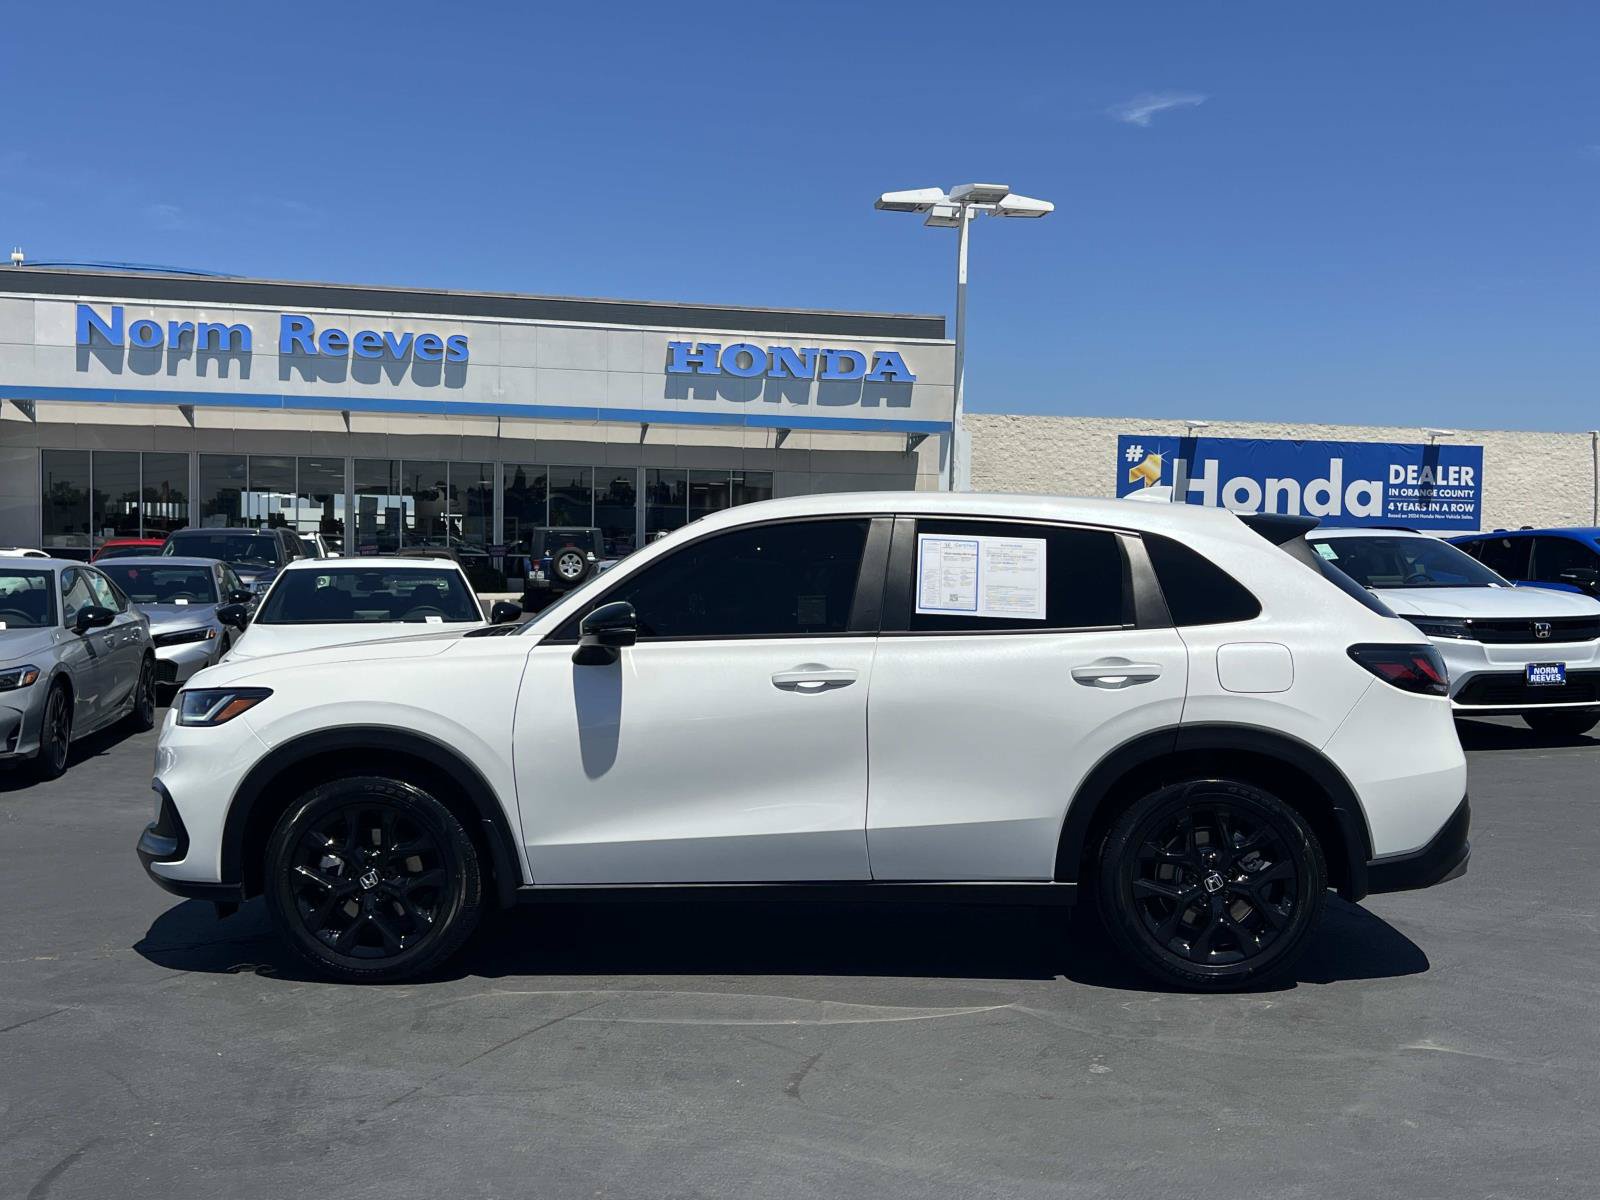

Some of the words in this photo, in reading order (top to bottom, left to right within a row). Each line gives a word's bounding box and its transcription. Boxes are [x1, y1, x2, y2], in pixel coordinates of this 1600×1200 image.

[76, 304, 252, 352] Norm
[279, 314, 470, 362] Reeves
[667, 341, 917, 382] HONDA
[1389, 464, 1475, 487] DEALER
[1172, 458, 1384, 518] Honda
[1388, 488, 1399, 496] IN
[1400, 488, 1438, 498] ORANGE
[1439, 489, 1475, 498] COUNTY
[1388, 502, 1395, 511] 4
[1396, 502, 1427, 512] YEARS
[1428, 503, 1440, 512] IN
[1441, 503, 1449, 512] A
[1450, 503, 1475, 513] ROW
[1530, 674, 1561, 682] REEVES
[1533, 667, 1559, 675] NORM
